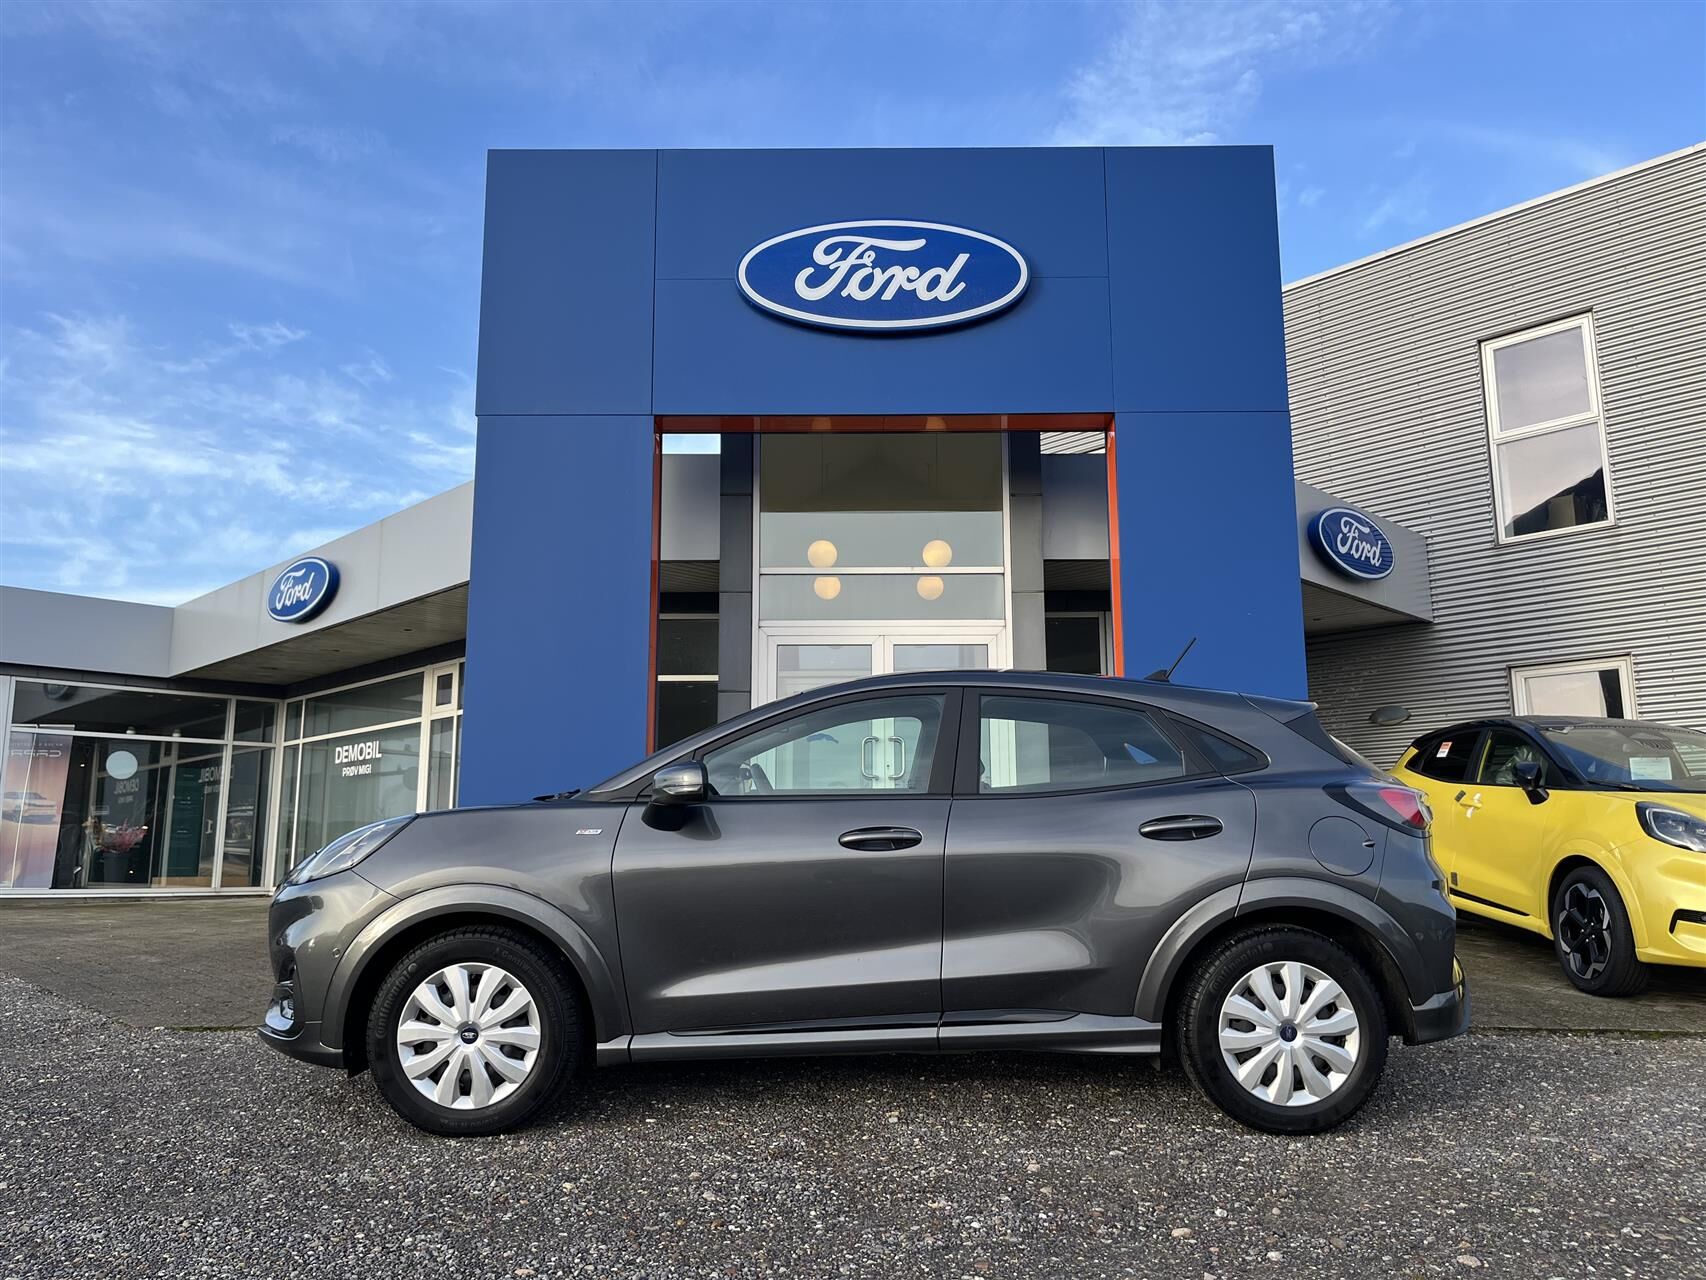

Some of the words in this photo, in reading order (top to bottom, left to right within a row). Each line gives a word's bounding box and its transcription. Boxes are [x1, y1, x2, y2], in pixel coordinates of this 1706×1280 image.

[795, 235, 970, 301] Ford
[1337, 516, 1382, 567] Ford
[275, 568, 315, 610] Ford
[335, 740, 382, 764] DEMOBIL
